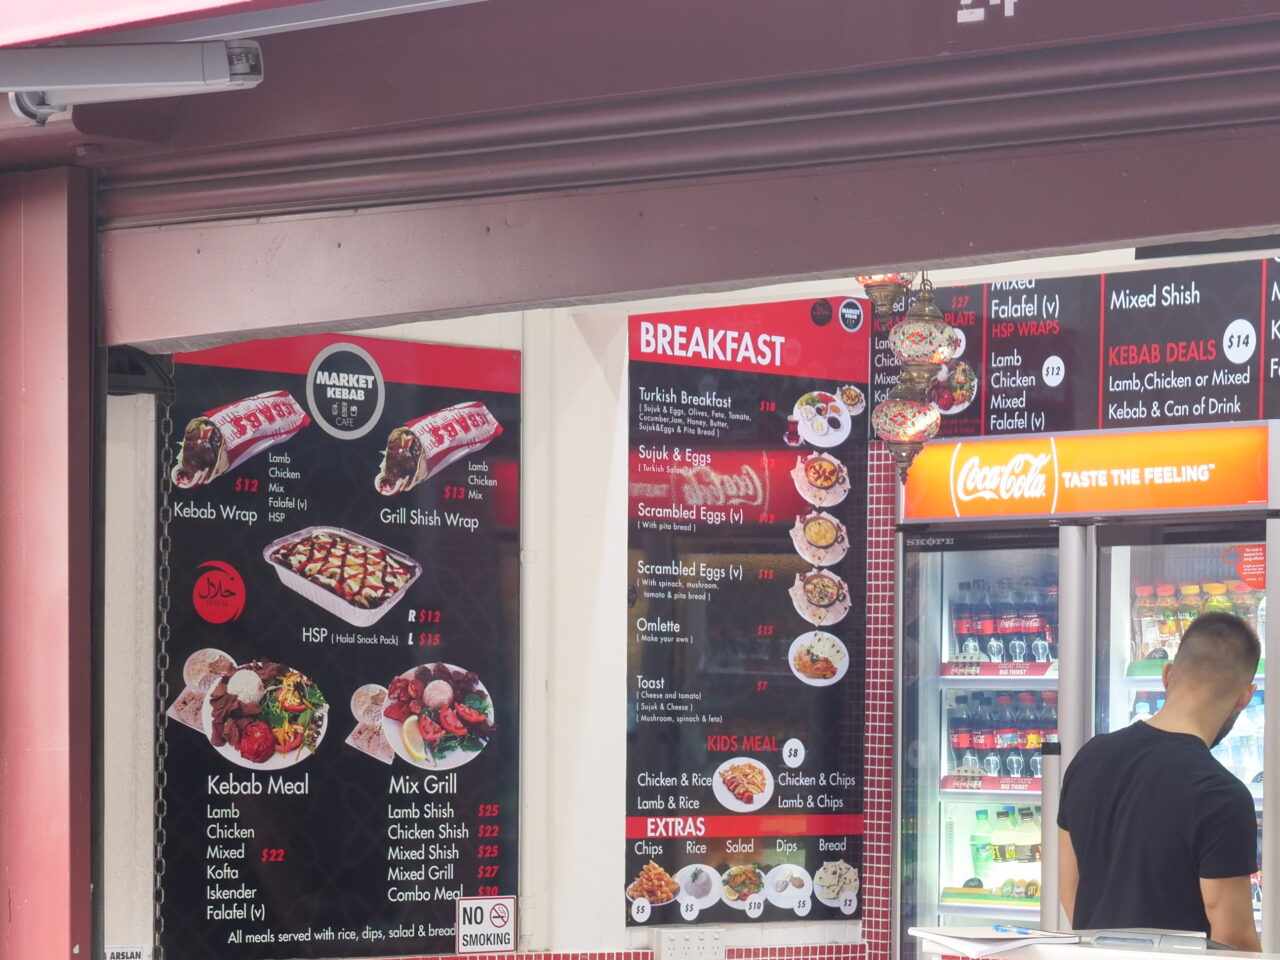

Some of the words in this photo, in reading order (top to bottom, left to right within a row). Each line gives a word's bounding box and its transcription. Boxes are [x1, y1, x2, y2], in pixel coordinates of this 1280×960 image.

[1110, 283, 1156, 310] Mixed
[1161, 281, 1200, 307] Shish
[991, 295, 1038, 319] Falafel
[1042, 294, 1060, 318] (v)
[992, 323, 1014, 339] HSP
[1018, 319, 1060, 337] WRAPS
[639, 321, 785, 367] BREAKFAST
[1227, 334, 1250, 349] $14
[991, 349, 1022, 367] Lamb
[1108, 343, 1160, 367] KEBAB
[1167, 339, 1217, 362] DEALS
[315, 370, 375, 389] MARKET
[991, 370, 1036, 389] Chicken
[1044, 365, 1061, 376] $12
[1109, 370, 1192, 393] Lamb,Chicken
[1195, 376, 1208, 387] or
[1211, 367, 1251, 386] Mixed
[326, 386, 366, 401] KEBAB
[638, 386, 677, 404] Turkish
[681, 390, 732, 409] Breakfast
[990, 390, 1026, 408] Mixed
[1108, 401, 1147, 420] Kebab
[1151, 402, 1160, 417] &
[1164, 400, 1189, 417] Can
[1192, 398, 1205, 415] of
[1208, 395, 1241, 414] Drink
[335, 416, 355, 428] CAFE
[990, 413, 1028, 430] Falafel
[1031, 412, 1045, 430] (v)
[268, 452, 291, 464] Lamb
[638, 444, 669, 463] Sujuk
[673, 447, 681, 461] &
[685, 448, 711, 467] Eggs
[268, 465, 301, 479] Chicken
[957, 453, 1051, 501] Coca-Cola
[1062, 470, 1108, 488] TASTE
[1111, 468, 1141, 485] THE
[268, 482, 285, 493] Mix
[468, 489, 483, 500] Mix
[174, 502, 216, 519] Kebab
[219, 504, 258, 525] Wrap
[268, 498, 295, 509] Falafel
[297, 499, 308, 512] (v)
[638, 502, 696, 520] Scrambled
[700, 506, 726, 525] Eggs
[729, 508, 743, 525] (v)
[268, 512, 286, 523] HSP
[380, 508, 406, 524] Grill
[410, 509, 441, 527] Shish
[445, 512, 480, 532] Wrap
[637, 560, 696, 577] Scrambled
[700, 563, 725, 581] Eggs
[729, 563, 743, 581] (v)
[637, 617, 681, 633] Omlette
[636, 675, 665, 689] Toast
[706, 735, 738, 752] KIDS
[743, 735, 778, 752] MEAL
[208, 772, 263, 795] Kebab
[267, 772, 309, 795] Meal
[389, 776, 420, 794] Mix
[424, 773, 457, 794] Grill
[638, 772, 678, 787] Chicken
[681, 774, 690, 786] &
[692, 773, 713, 787] Rice
[778, 771, 816, 786] Chicken
[819, 773, 827, 785] &
[829, 771, 856, 788] Chips
[207, 803, 240, 819] Lamb
[637, 797, 665, 810] Lamb
[668, 797, 677, 809] &
[679, 796, 700, 809] Rice
[207, 823, 255, 839] Chicken
[647, 817, 705, 837] EXTRAS
[206, 843, 245, 859] Mixed
[207, 863, 239, 879] Kofta
[207, 883, 257, 900] Iskender
[207, 903, 247, 920] Falafel
[250, 903, 265, 921] (v)
[462, 906, 484, 925] NO
[228, 930, 242, 944] All
[245, 930, 275, 943] meals
[278, 927, 311, 942] served
[313, 926, 335, 941] with
[337, 928, 359, 942] rice,
[362, 924, 386, 942] dips,
[388, 924, 415, 938] salad
[418, 924, 426, 937] &
[462, 932, 511, 947] SMOKING
[110, 951, 142, 960] ARSLAN
